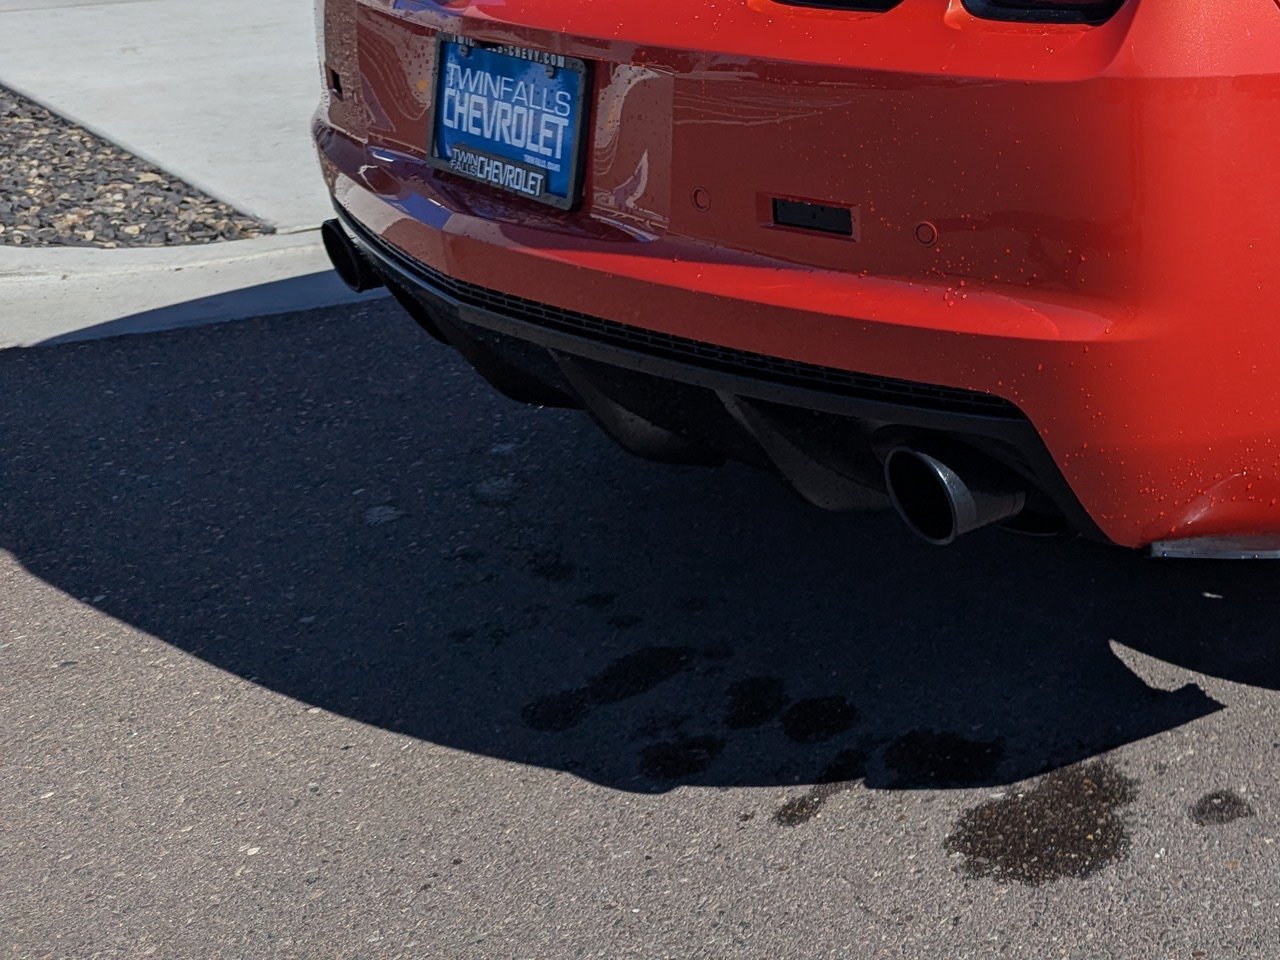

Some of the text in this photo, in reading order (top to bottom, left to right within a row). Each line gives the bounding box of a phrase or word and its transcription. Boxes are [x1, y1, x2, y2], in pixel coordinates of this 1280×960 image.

[443, 87, 569, 159] CHEVROLET
[450, 159, 478, 176] FALLS
[452, 148, 480, 166] TWIN
[476, 156, 544, 196] CHEVROLET
